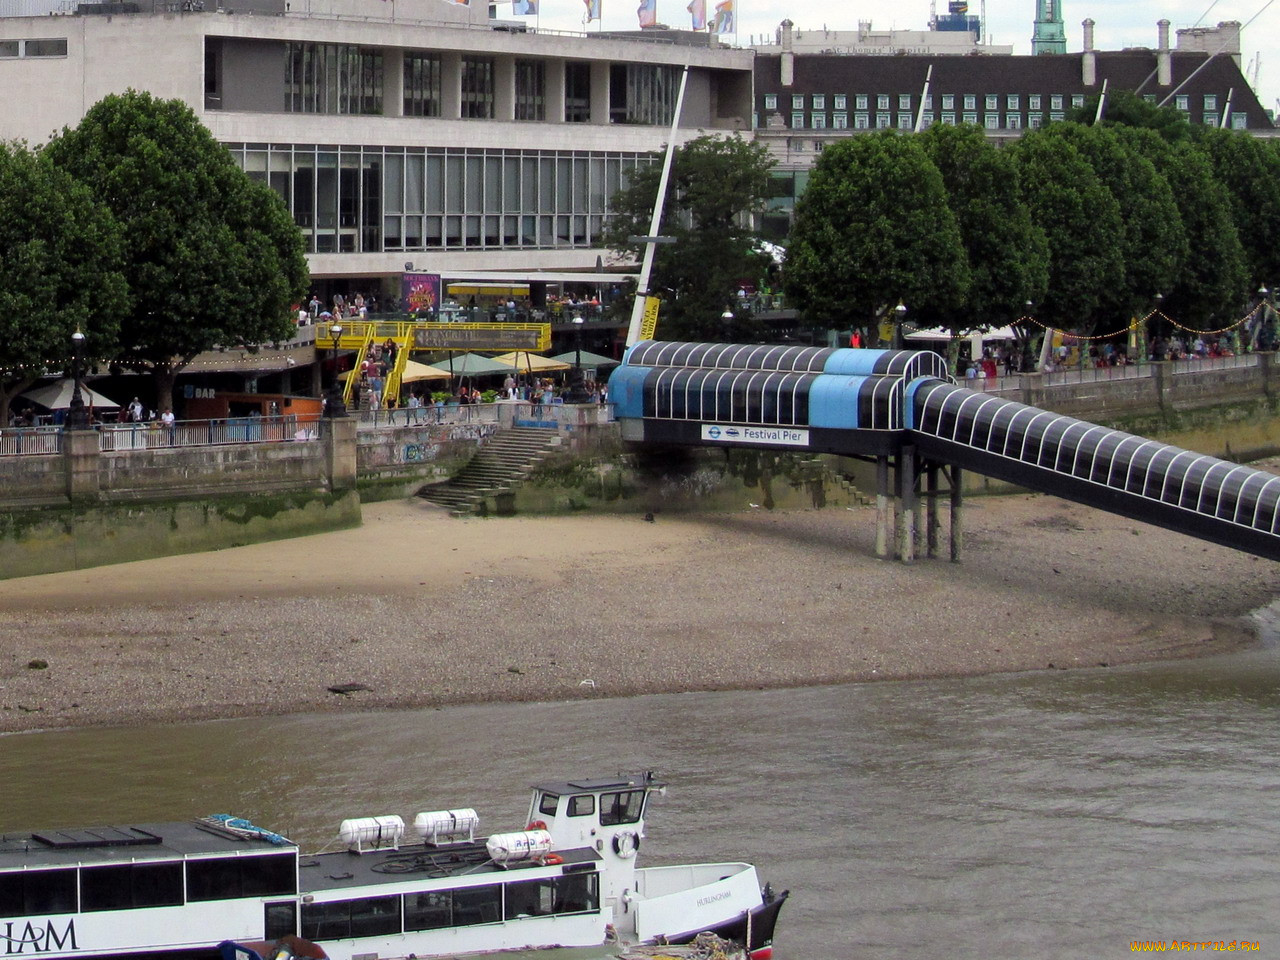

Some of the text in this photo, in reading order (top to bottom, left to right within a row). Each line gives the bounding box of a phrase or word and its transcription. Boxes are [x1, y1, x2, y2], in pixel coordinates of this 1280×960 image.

[195, 388, 216, 399] BAR
[744, 429, 802, 441] Festival Pier
[696, 890, 732, 907] HURLINGHAM
